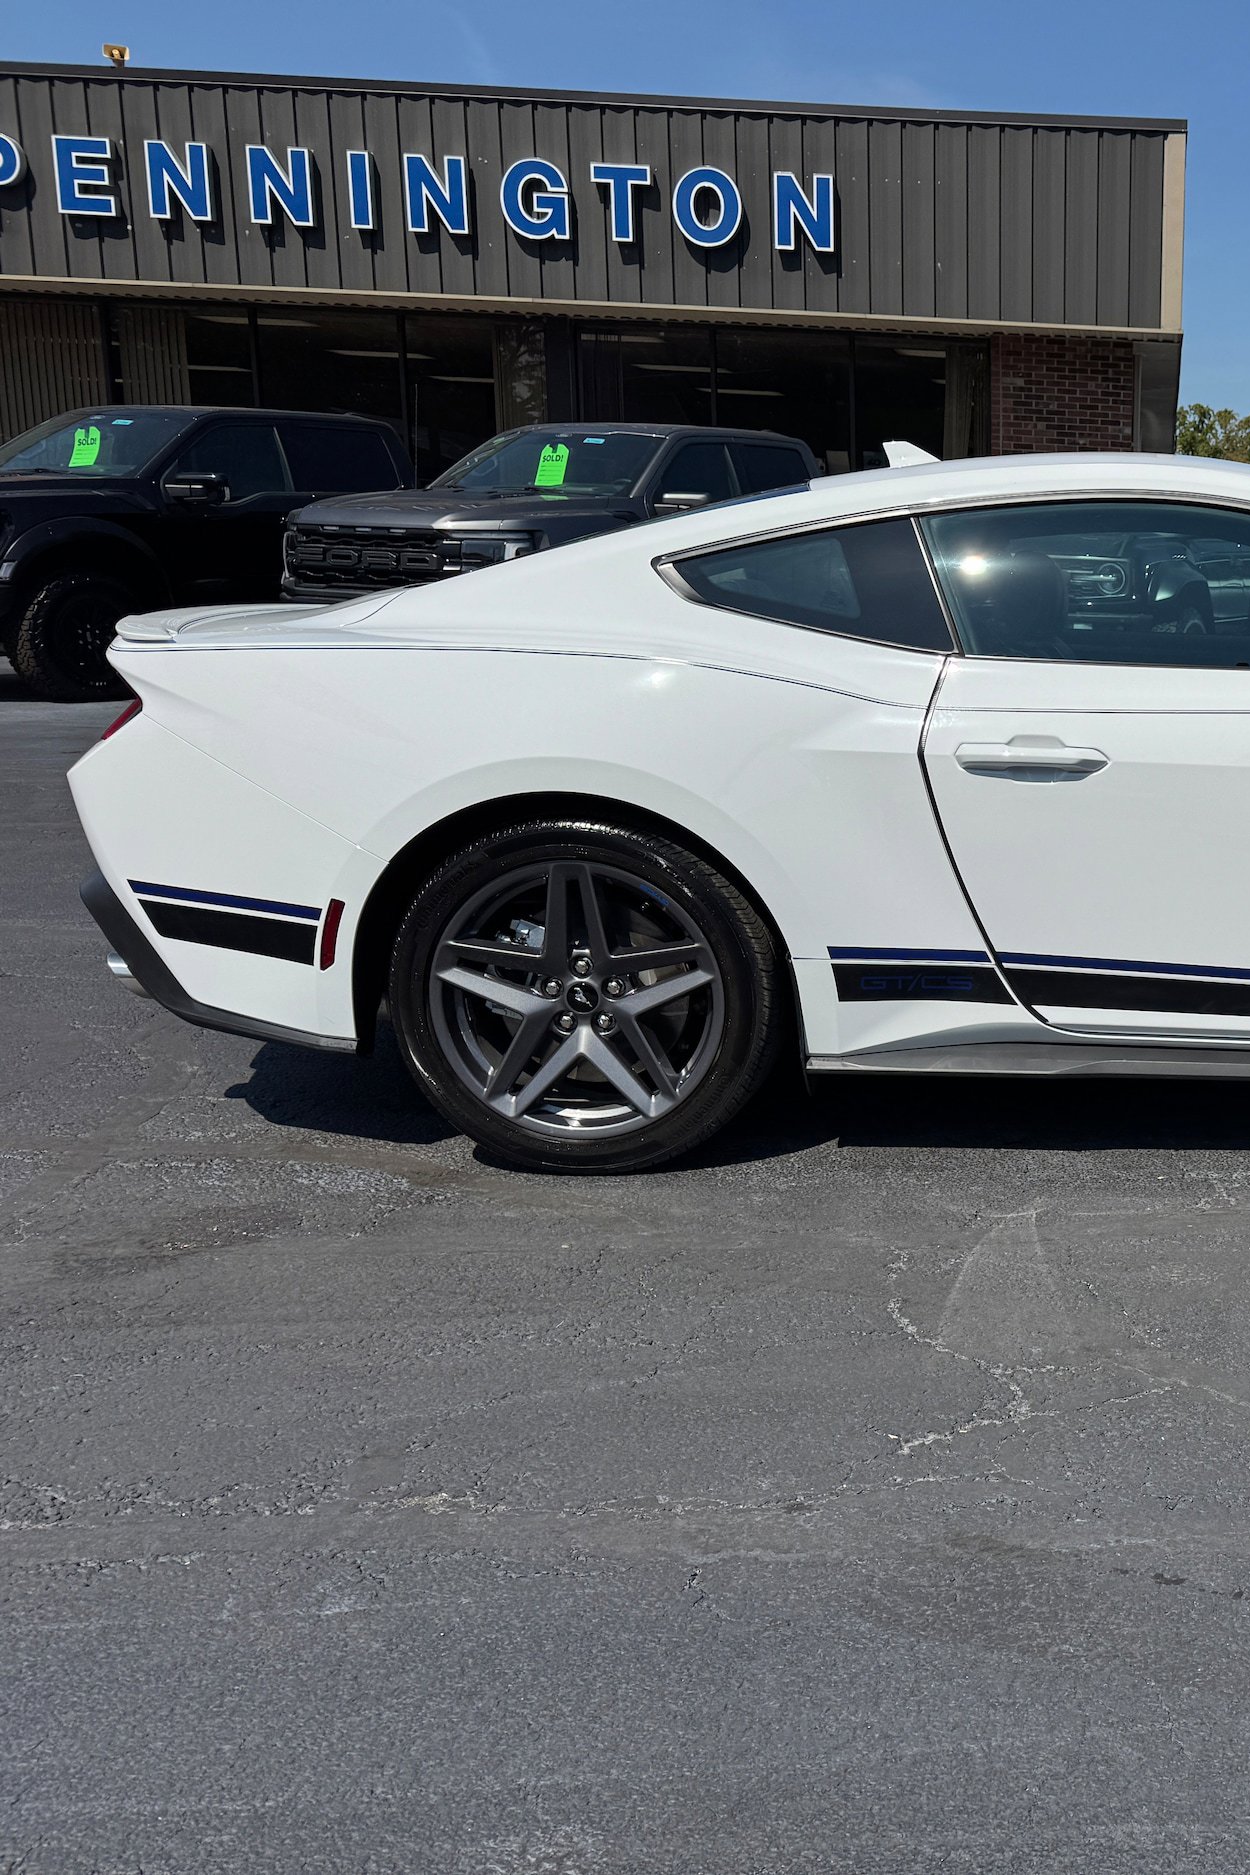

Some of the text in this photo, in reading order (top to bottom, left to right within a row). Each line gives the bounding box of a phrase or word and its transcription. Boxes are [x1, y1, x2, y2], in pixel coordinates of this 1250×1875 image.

[77, 438, 97, 446] SOLD!
[542, 455, 564, 463] SOLD!
[295, 547, 440, 571] FORD
[860, 973, 974, 992] GT/CS
